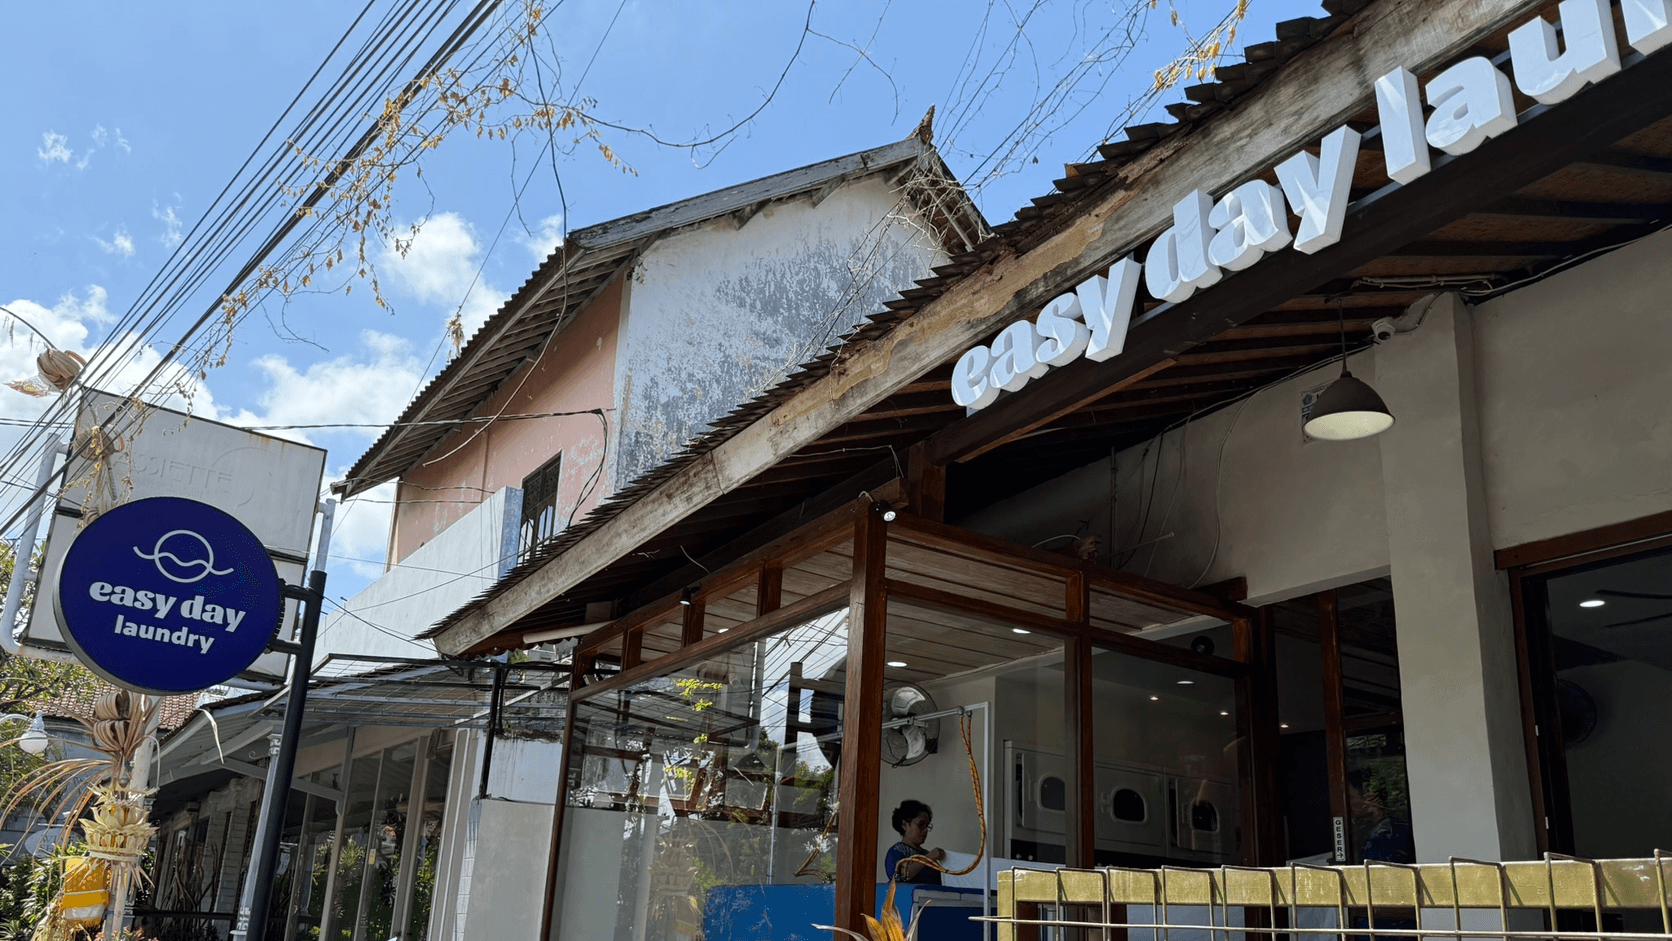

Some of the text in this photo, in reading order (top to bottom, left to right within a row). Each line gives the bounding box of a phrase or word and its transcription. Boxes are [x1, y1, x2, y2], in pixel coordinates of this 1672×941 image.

[951, 257, 1142, 411] easy
[1144, 124, 1362, 304] day
[89, 581, 247, 633] easy day
[114, 614, 215, 654] laundry
[1335, 819, 1343, 853] GESER
